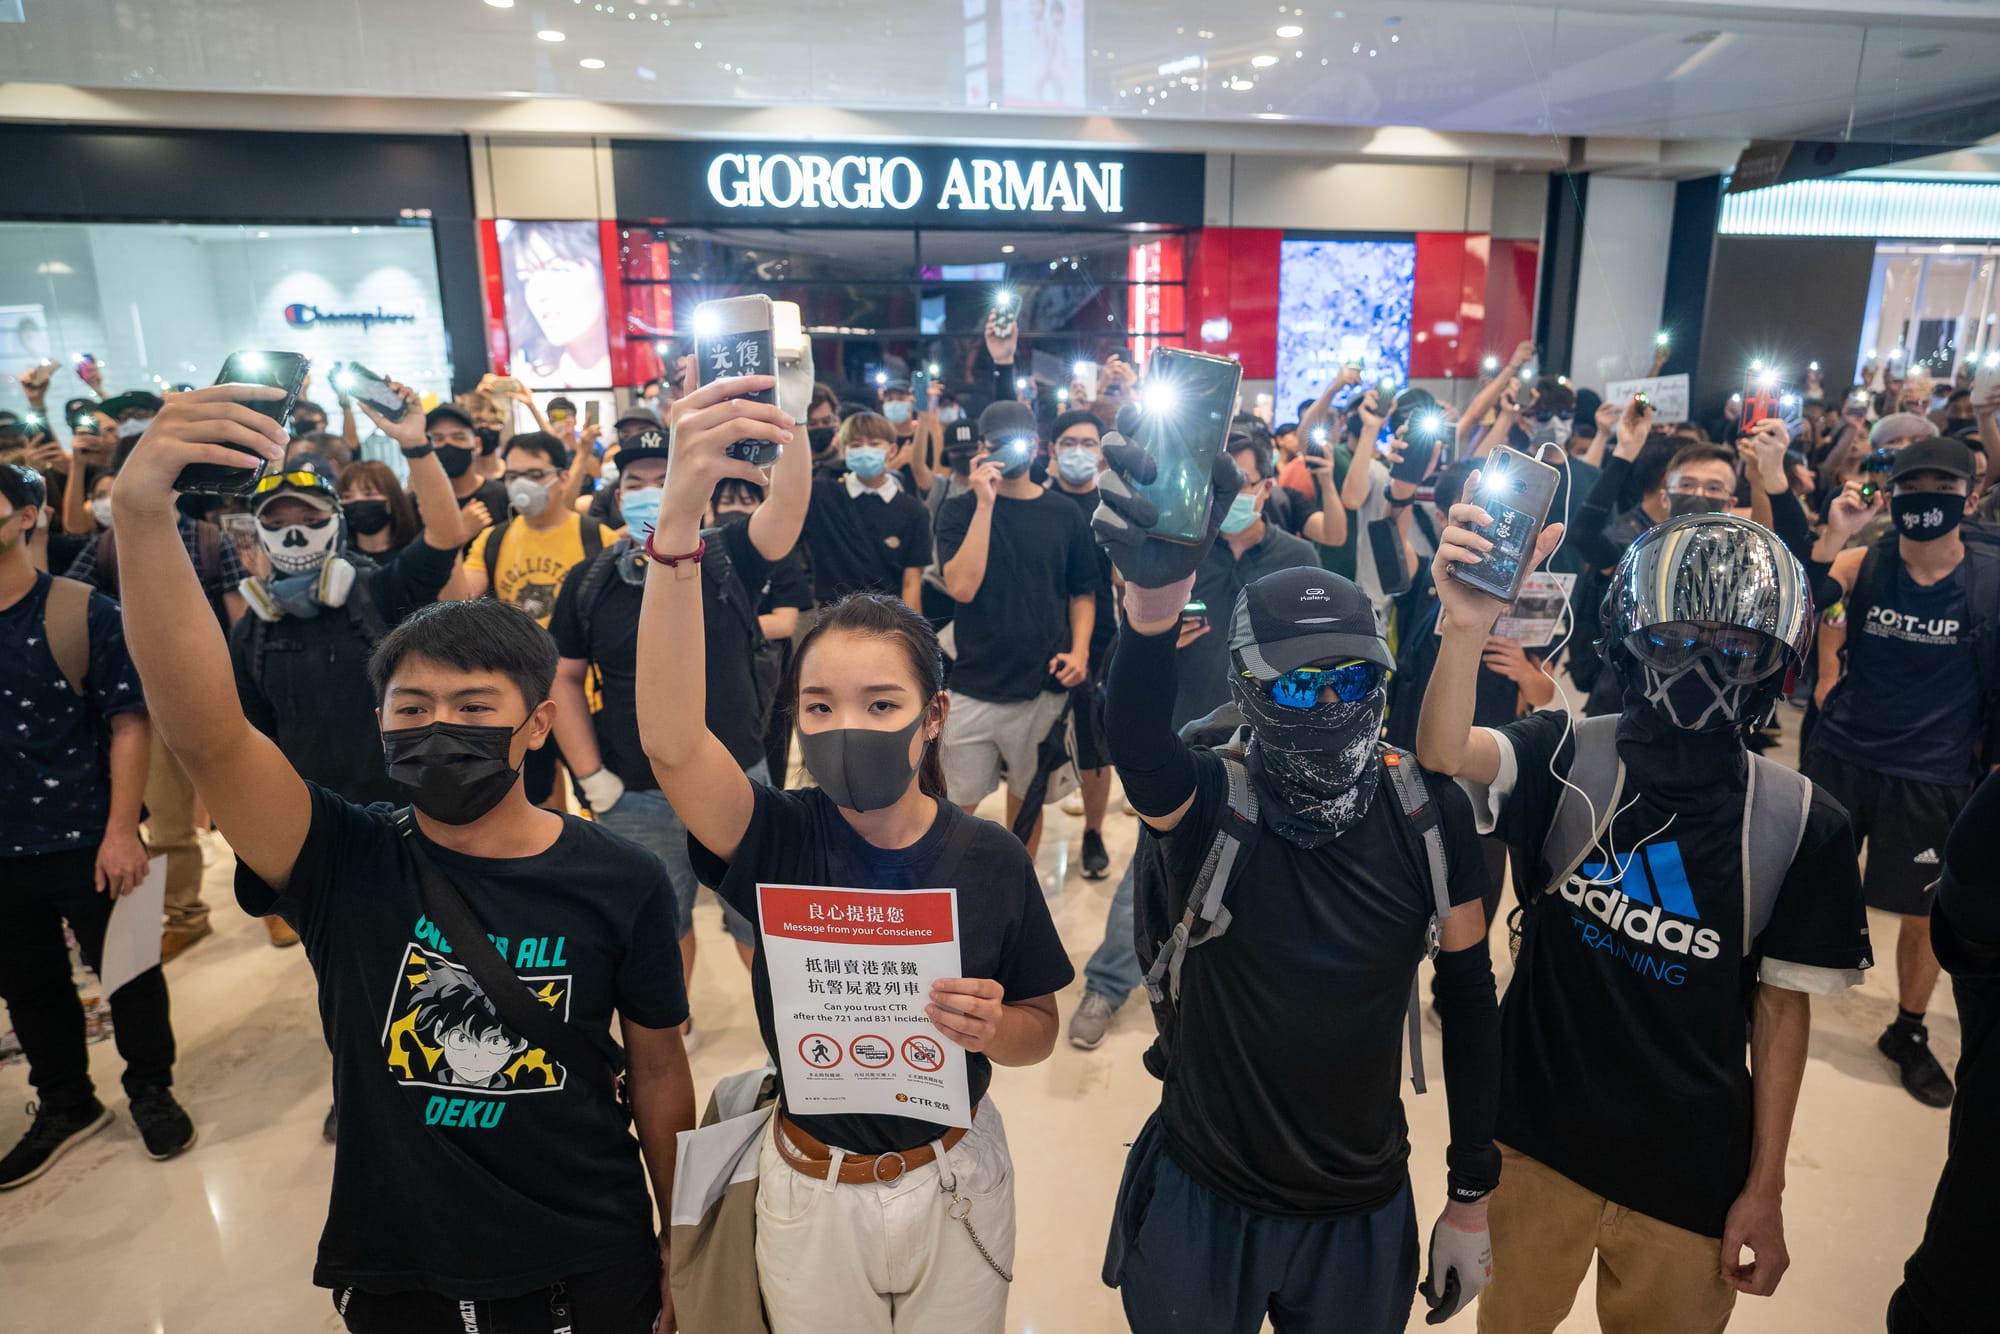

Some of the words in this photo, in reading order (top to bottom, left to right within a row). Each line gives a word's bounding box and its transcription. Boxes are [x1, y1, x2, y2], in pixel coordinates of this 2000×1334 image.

[707, 153, 923, 210] GIORGIO
[937, 157, 1124, 213] ARMANI
[809, 903, 904, 923] 良心提提您
[1559, 874, 1721, 960] adidas
[783, 922, 825, 934] Message
[826, 924, 850, 934] from
[851, 927, 875, 936] your
[876, 927, 933, 937] Conscience
[515, 936, 567, 968] ALL
[1570, 916, 1687, 985] TRAINING
[805, 957, 919, 977] 抵制賣港黨鐵
[808, 978, 920, 996] 抗警屍殺列車
[824, 1002, 842, 1011] Can
[844, 1004, 862, 1012] you
[793, 1012, 815, 1021] after
[817, 1014, 833, 1022] the
[854, 1015, 873, 1023] and
[874, 1015, 891, 1023] 831
[894, 1015, 932, 1023] inciden
[910, 1096, 933, 1107] CTR
[425, 1095, 506, 1129] DEKU
